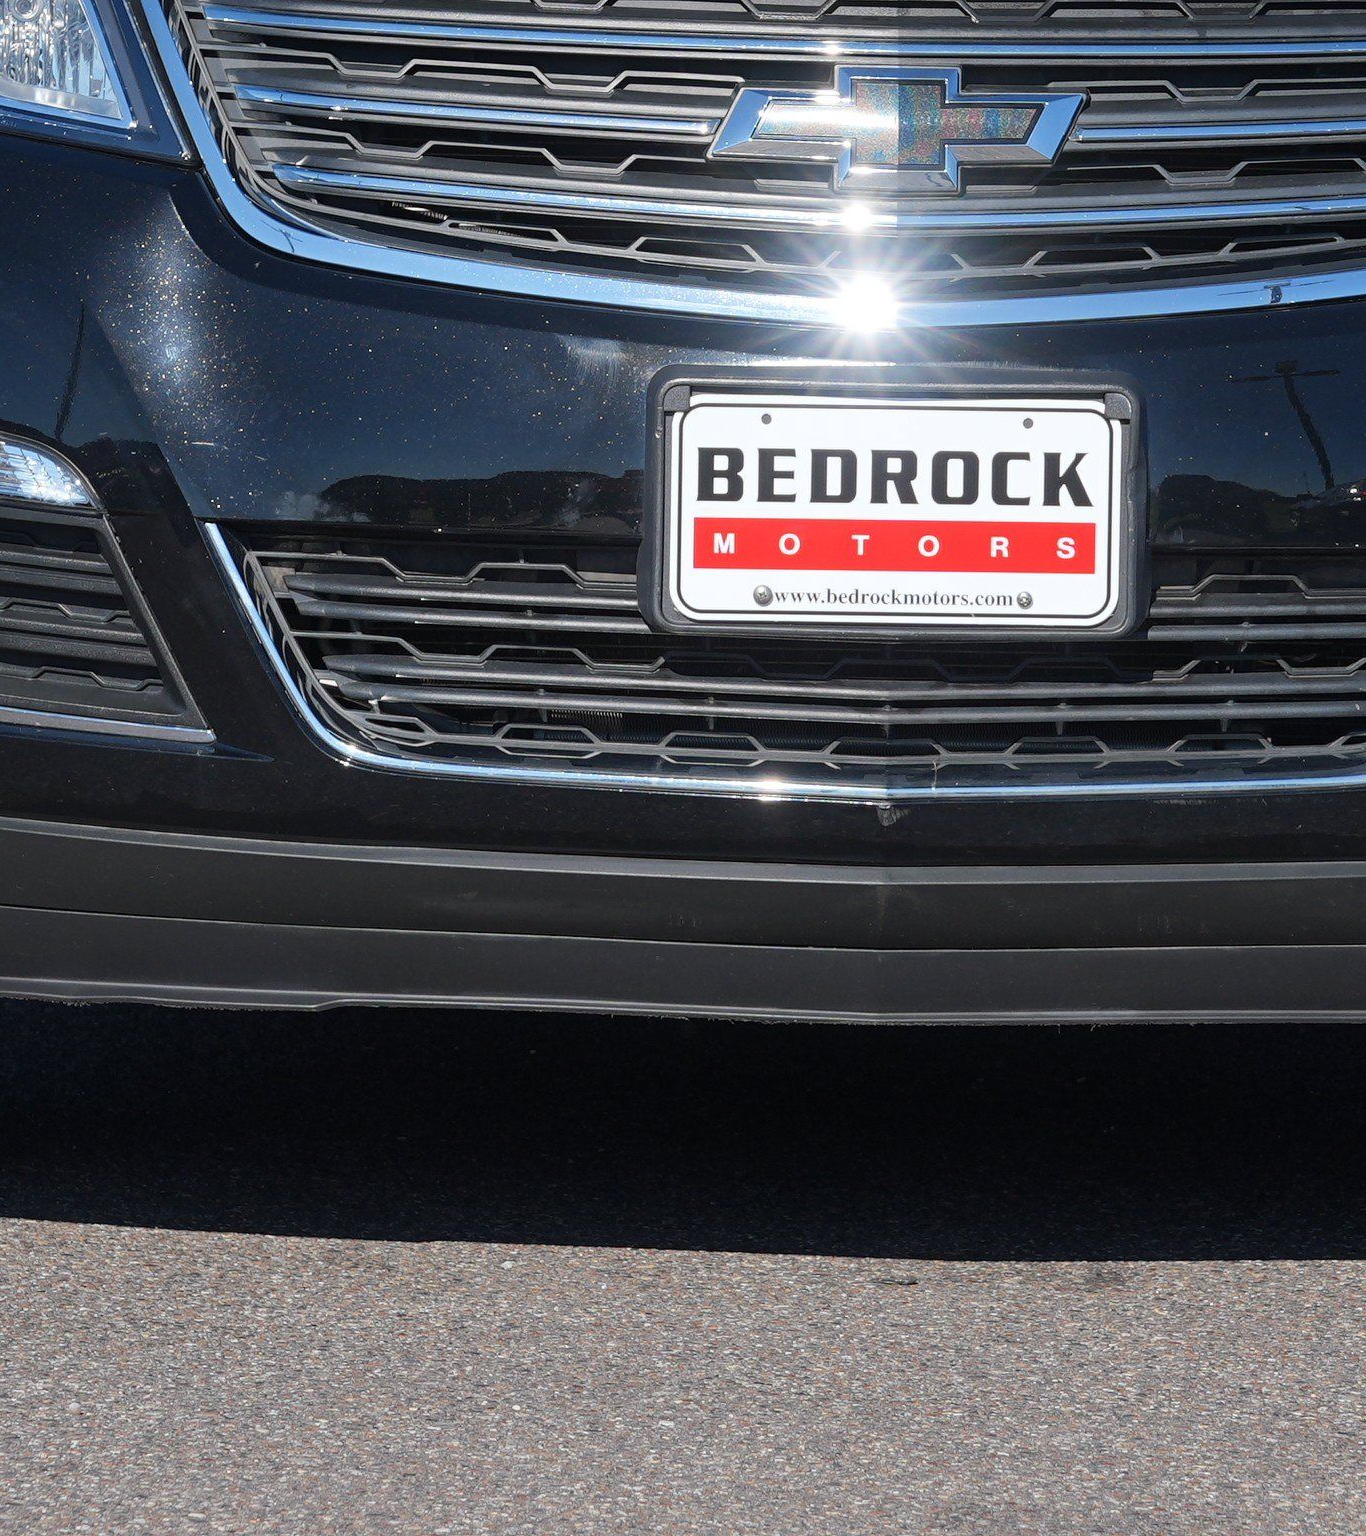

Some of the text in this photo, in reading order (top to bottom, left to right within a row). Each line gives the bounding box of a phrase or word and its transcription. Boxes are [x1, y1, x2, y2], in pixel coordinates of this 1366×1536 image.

[696, 447, 1094, 507] BEDROCK
[712, 532, 1077, 561] MOTORS
[775, 588, 1014, 607] www.bedrockmotors.com
